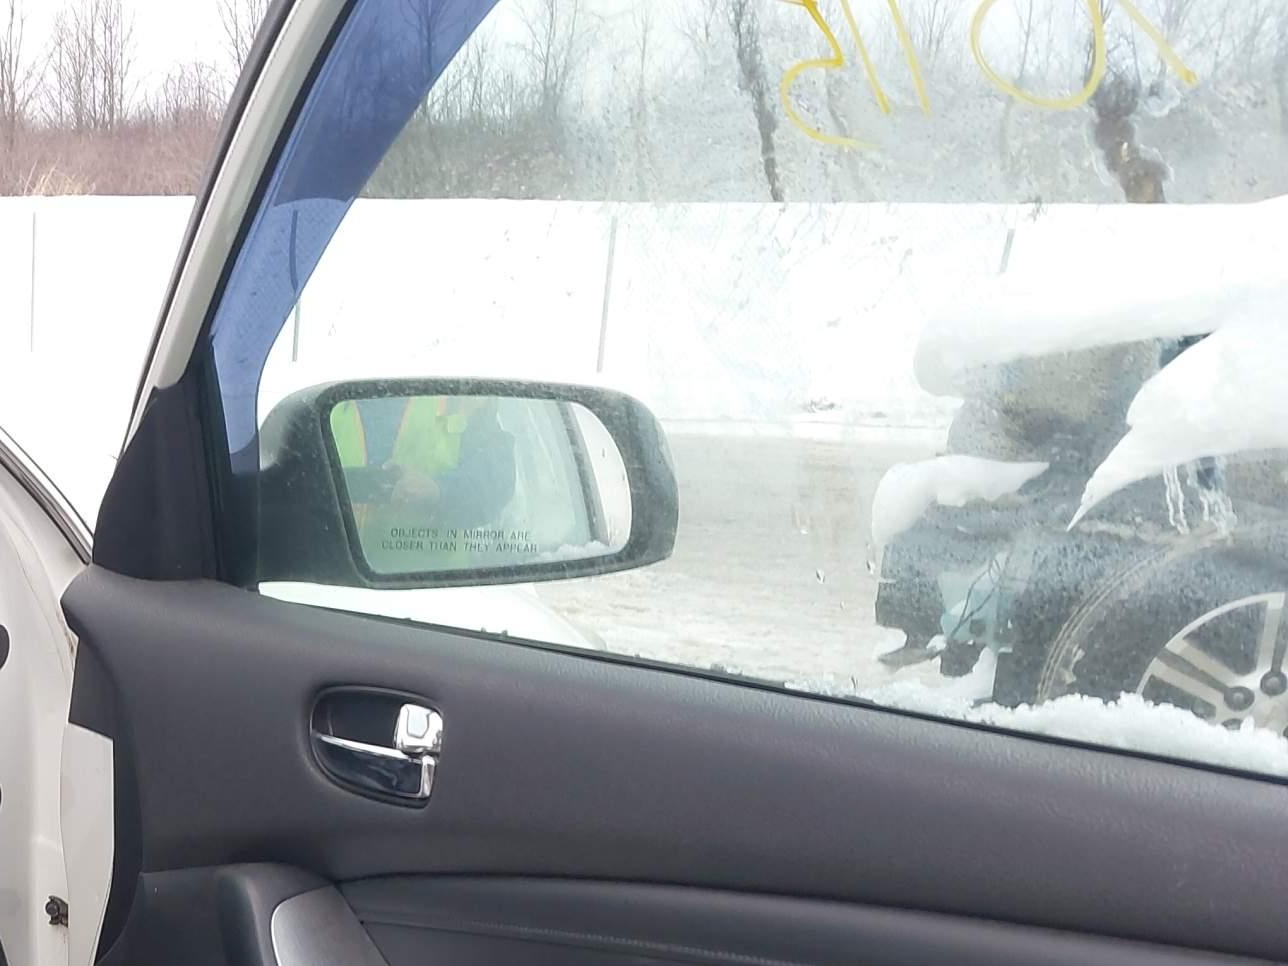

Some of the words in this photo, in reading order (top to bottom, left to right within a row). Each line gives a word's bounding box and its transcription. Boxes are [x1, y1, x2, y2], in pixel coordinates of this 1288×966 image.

[390, 528, 439, 539] OBJECTS
[447, 528, 457, 539] IN
[463, 529, 505, 541] MIRROR
[510, 530, 531, 541] ARE
[381, 539, 424, 550] CLOSER
[430, 540, 457, 551] THAN
[463, 542, 490, 553] THEY
[496, 542, 537, 553] APPEAR
